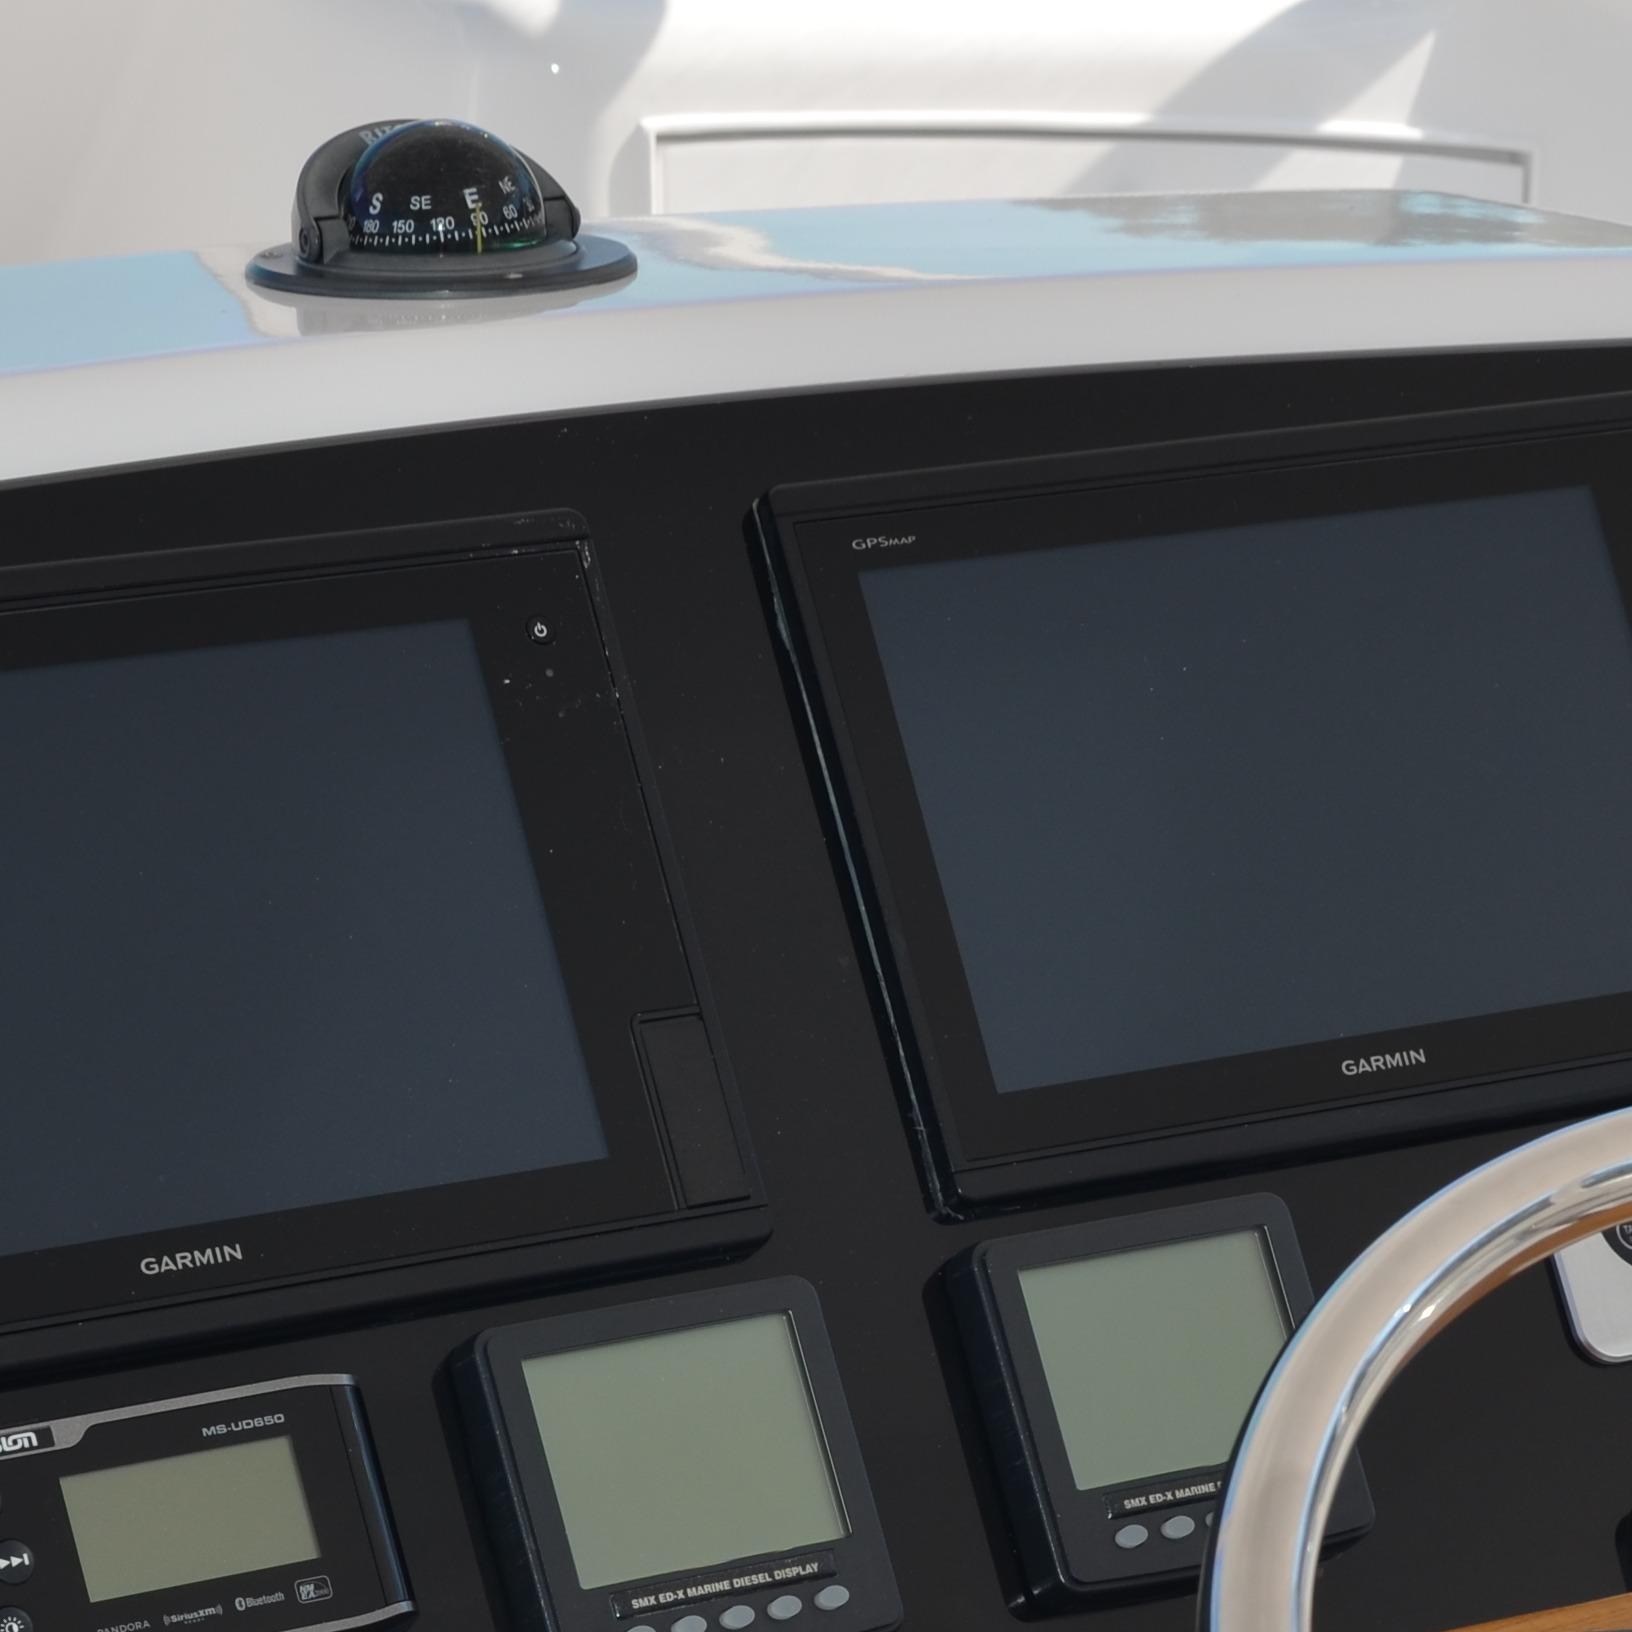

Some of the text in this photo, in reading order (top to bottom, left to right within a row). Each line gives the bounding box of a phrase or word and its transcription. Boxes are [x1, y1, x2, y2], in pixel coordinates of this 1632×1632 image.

[369, 192, 383, 215] S
[409, 195, 432, 210] SE
[463, 187, 481, 209] E
[363, 219, 380, 233] 180
[392, 219, 414, 233] 150
[430, 216, 455, 231] 120
[1341, 1048, 1427, 1076] GARMIN
[140, 1243, 243, 1275] GARMIN
[201, 1413, 285, 1437] MS-UD650
[1123, 1496, 1148, 1509] SMX
[1149, 1491, 1174, 1504] ED-X
[1175, 1482, 1216, 1499] MARINE
[245, 1590, 285, 1608] Bluetooth
[631, 1562, 819, 1610] SMX ED-X MARINE DIESEL DISPLAY
